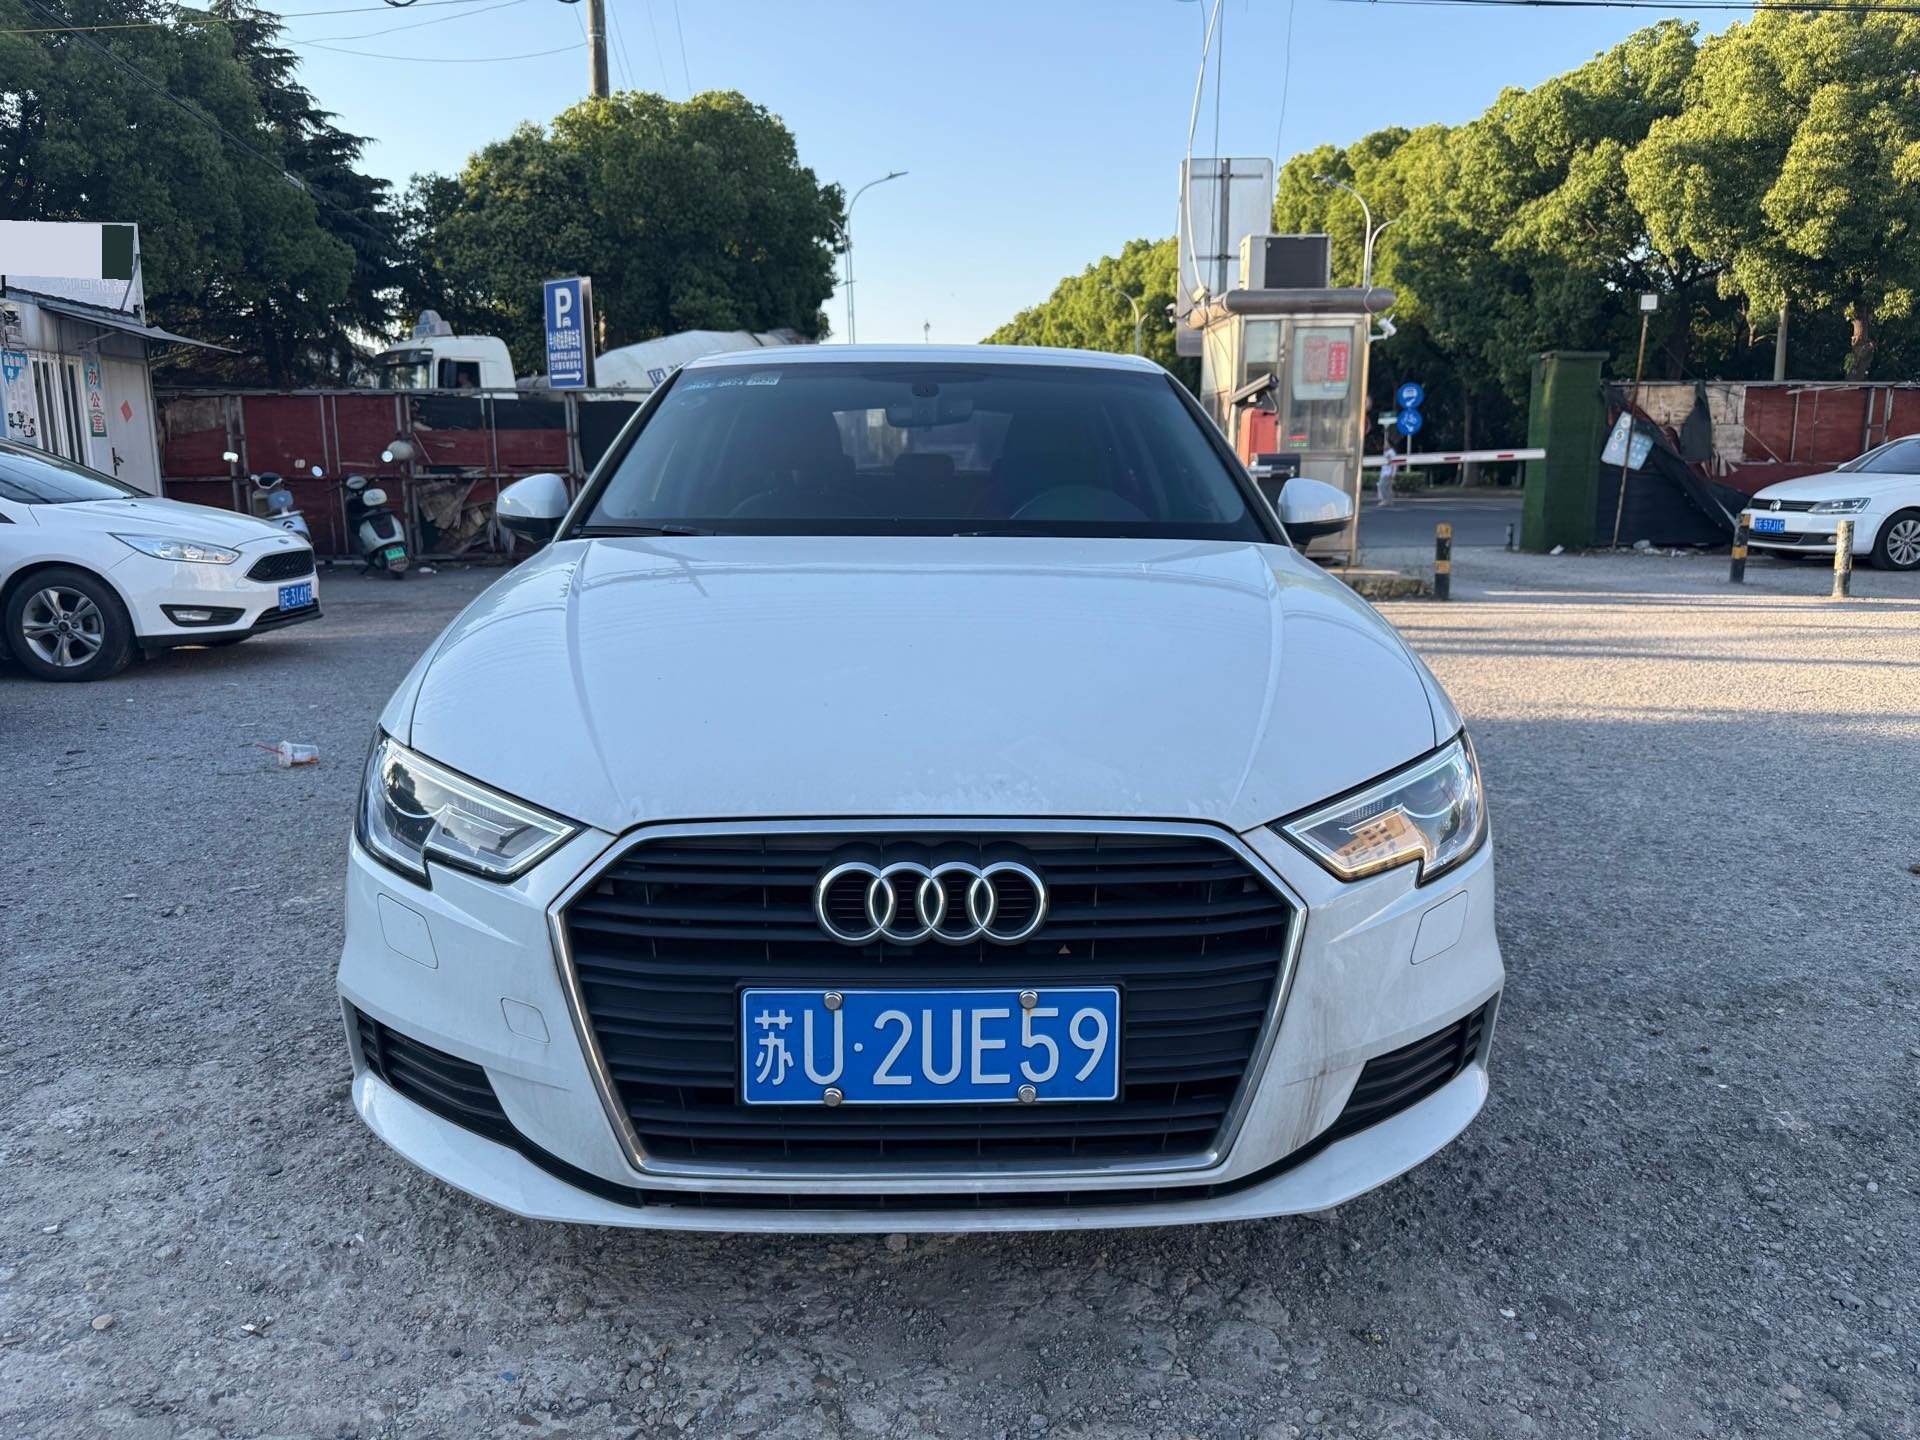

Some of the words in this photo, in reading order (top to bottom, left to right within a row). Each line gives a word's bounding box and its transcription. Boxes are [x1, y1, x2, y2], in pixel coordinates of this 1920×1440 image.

[555, 287, 572, 328] P
[88, 368, 104, 432] 办公室
